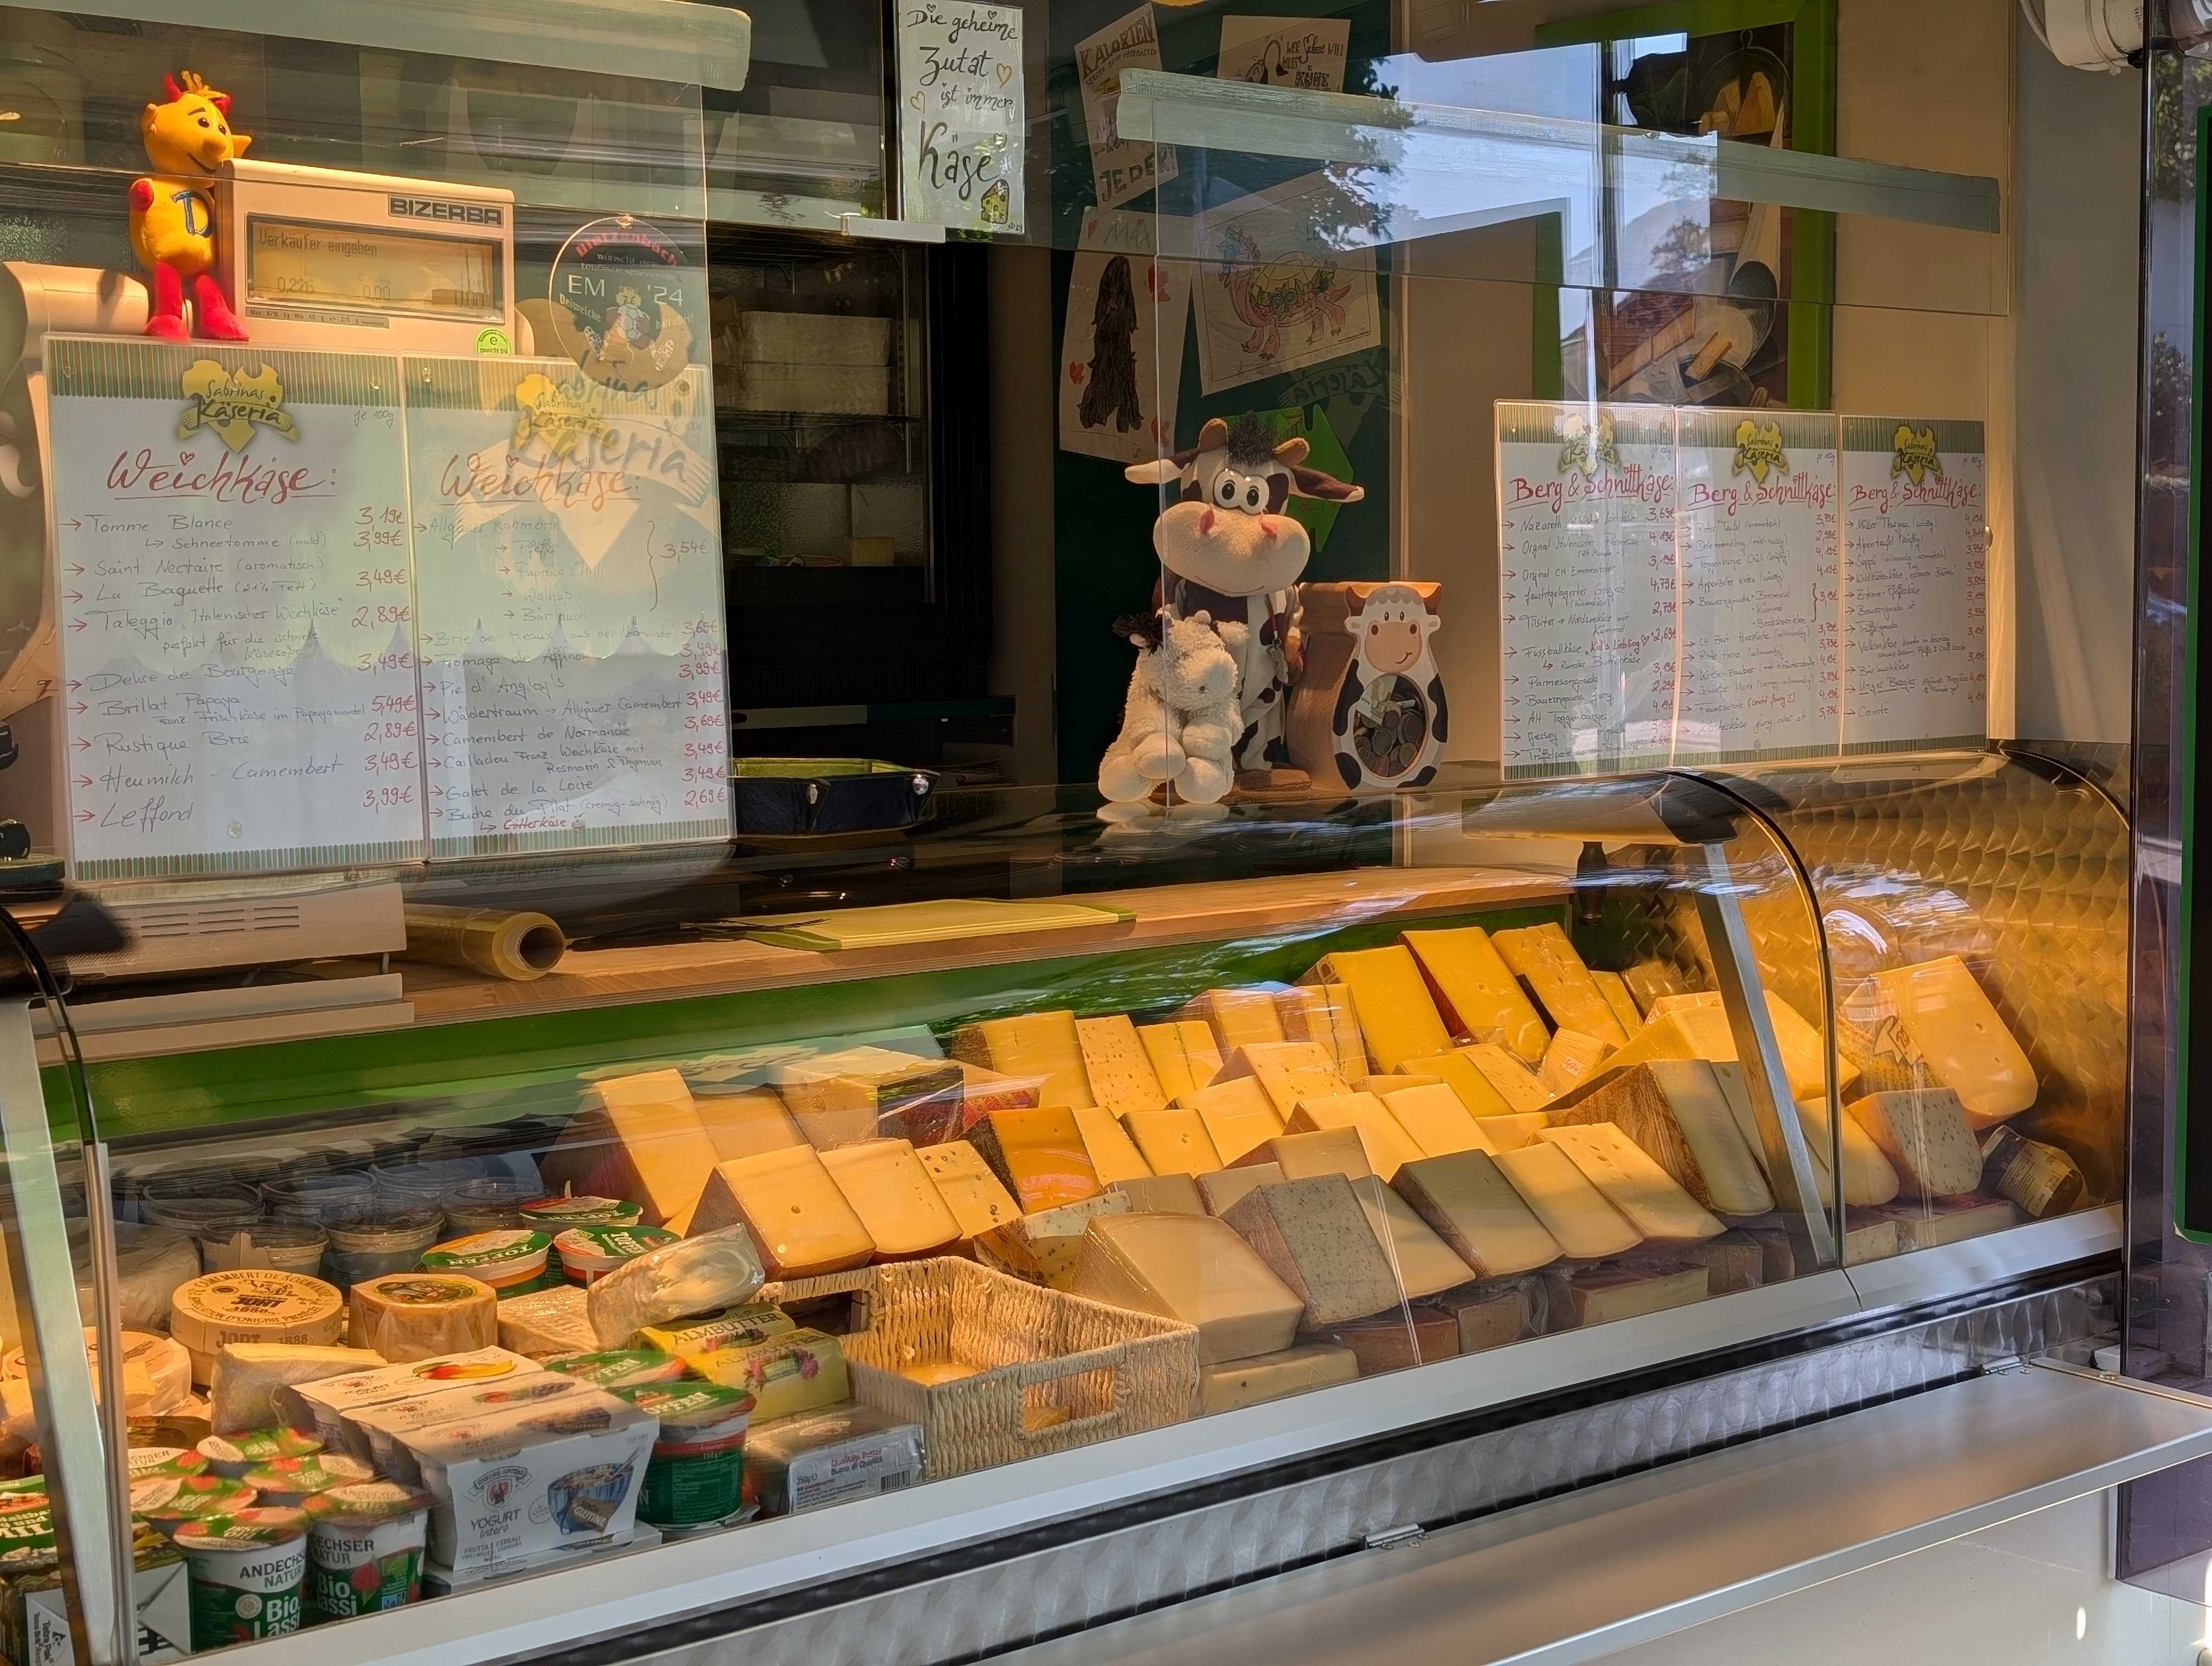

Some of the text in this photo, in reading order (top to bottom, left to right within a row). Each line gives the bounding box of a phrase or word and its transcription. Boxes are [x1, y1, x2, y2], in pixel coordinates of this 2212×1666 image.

[907, 10, 1018, 43] Die geheime
[1079, 11, 1155, 80] KALORIEN
[919, 47, 993, 86] Zutat
[941, 82, 1013, 111] ist immer
[918, 120, 999, 201] Käse
[390, 196, 503, 226] BIZERBA
[260, 228, 377, 258] Verkäufer eingeben
[568, 274, 605, 297] EM
[197, 395, 282, 428] Käseria
[107, 449, 337, 504] Weichkäse:
[1506, 477, 1564, 514] Berg
[1567, 472, 1579, 497] &
[1686, 483, 1739, 516] Berg
[1849, 484, 1889, 514] Berg
[85, 514, 150, 533] Tomme
[355, 507, 406, 531] 3,19€
[171, 539, 280, 550] Schneetomme
[353, 530, 404, 551] 3,99€
[659, 540, 711, 563] 3,54€
[94, 558, 140, 575] Saint
[155, 556, 225, 575] Nectaire
[137, 577, 224, 606] Baguette
[356, 569, 407, 592] 3,49€
[85, 608, 173, 640] Taleggio
[352, 606, 413, 629] 2,89€
[434, 631, 472, 648] Brie
[681, 621, 720, 642] 3,69€
[162, 635, 208, 657] perfekt
[216, 633, 239, 652] für
[244, 631, 265, 644] die
[86, 653, 415, 691] Delice de 3,49€
[434, 652, 503, 675] Fromage
[440, 680, 465, 696] Pie
[686, 691, 724, 707] 3,49€
[98, 693, 417, 716] Brillat Papaya 5,49€
[273, 708, 288, 720] im
[93, 721, 418, 761] Rustique Brie 2,89€
[442, 727, 528, 747] Camembert
[538, 728, 554, 739] de
[684, 714, 724, 733] 3,69€
[684, 742, 726, 761] 3,49€
[100, 751, 419, 793] Heumilch Camembert 3,49€
[681, 767, 727, 787] 3,49€
[363, 785, 415, 815] 3,99€
[446, 782, 489, 800] Galet
[500, 783, 517, 795] de
[531, 780, 546, 794] la
[504, 803, 525, 817] du
[684, 790, 728, 807] 2,69€
[673, 1312, 782, 1345] ALMBUTTER
[471, 1508, 521, 1531] YOGURT
[267, 1596, 300, 1623] Bio
